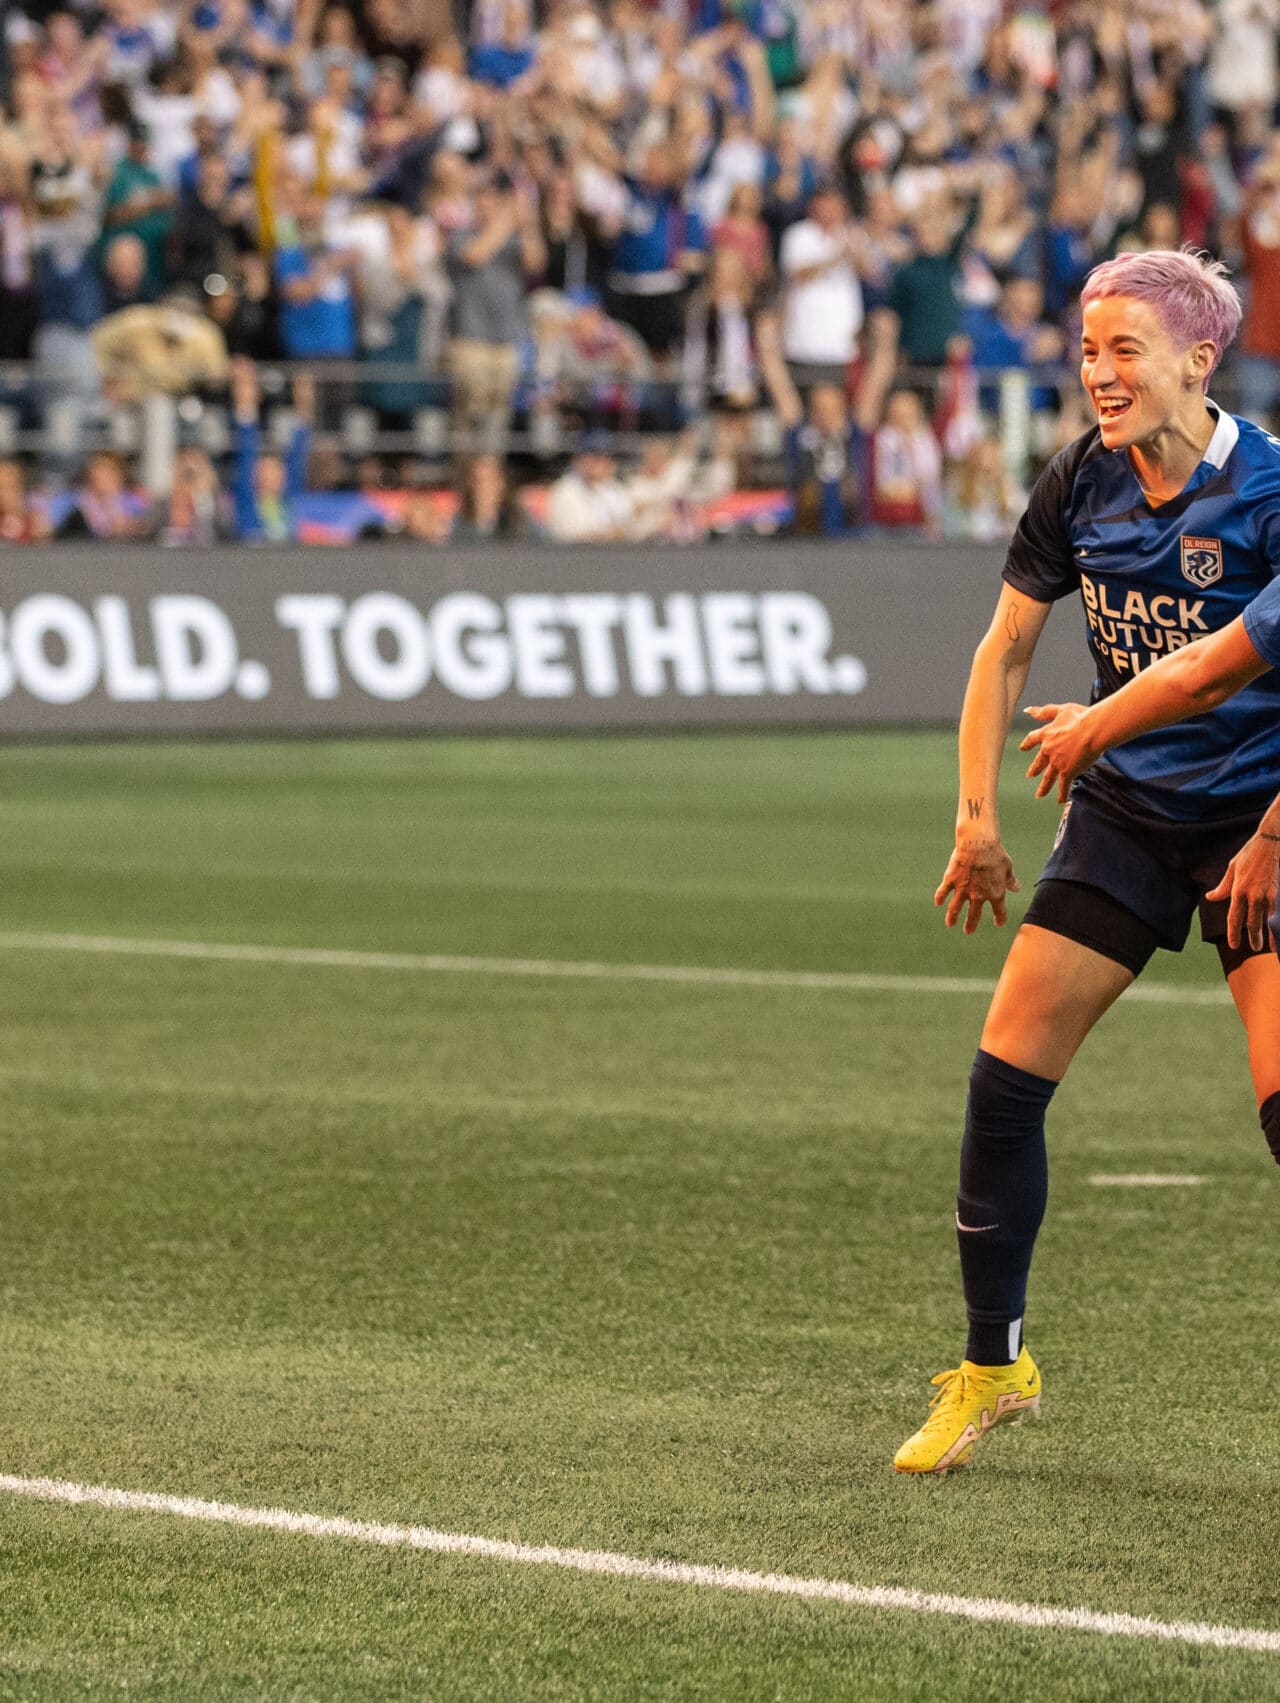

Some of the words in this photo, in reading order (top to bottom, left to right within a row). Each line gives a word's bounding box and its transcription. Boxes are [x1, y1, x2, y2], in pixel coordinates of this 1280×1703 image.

[1184, 539, 1195, 548] OL
[1195, 540, 1218, 550] REIGN
[1081, 573, 1208, 630] BLACK
[276, 591, 867, 700] TOGETHER.
